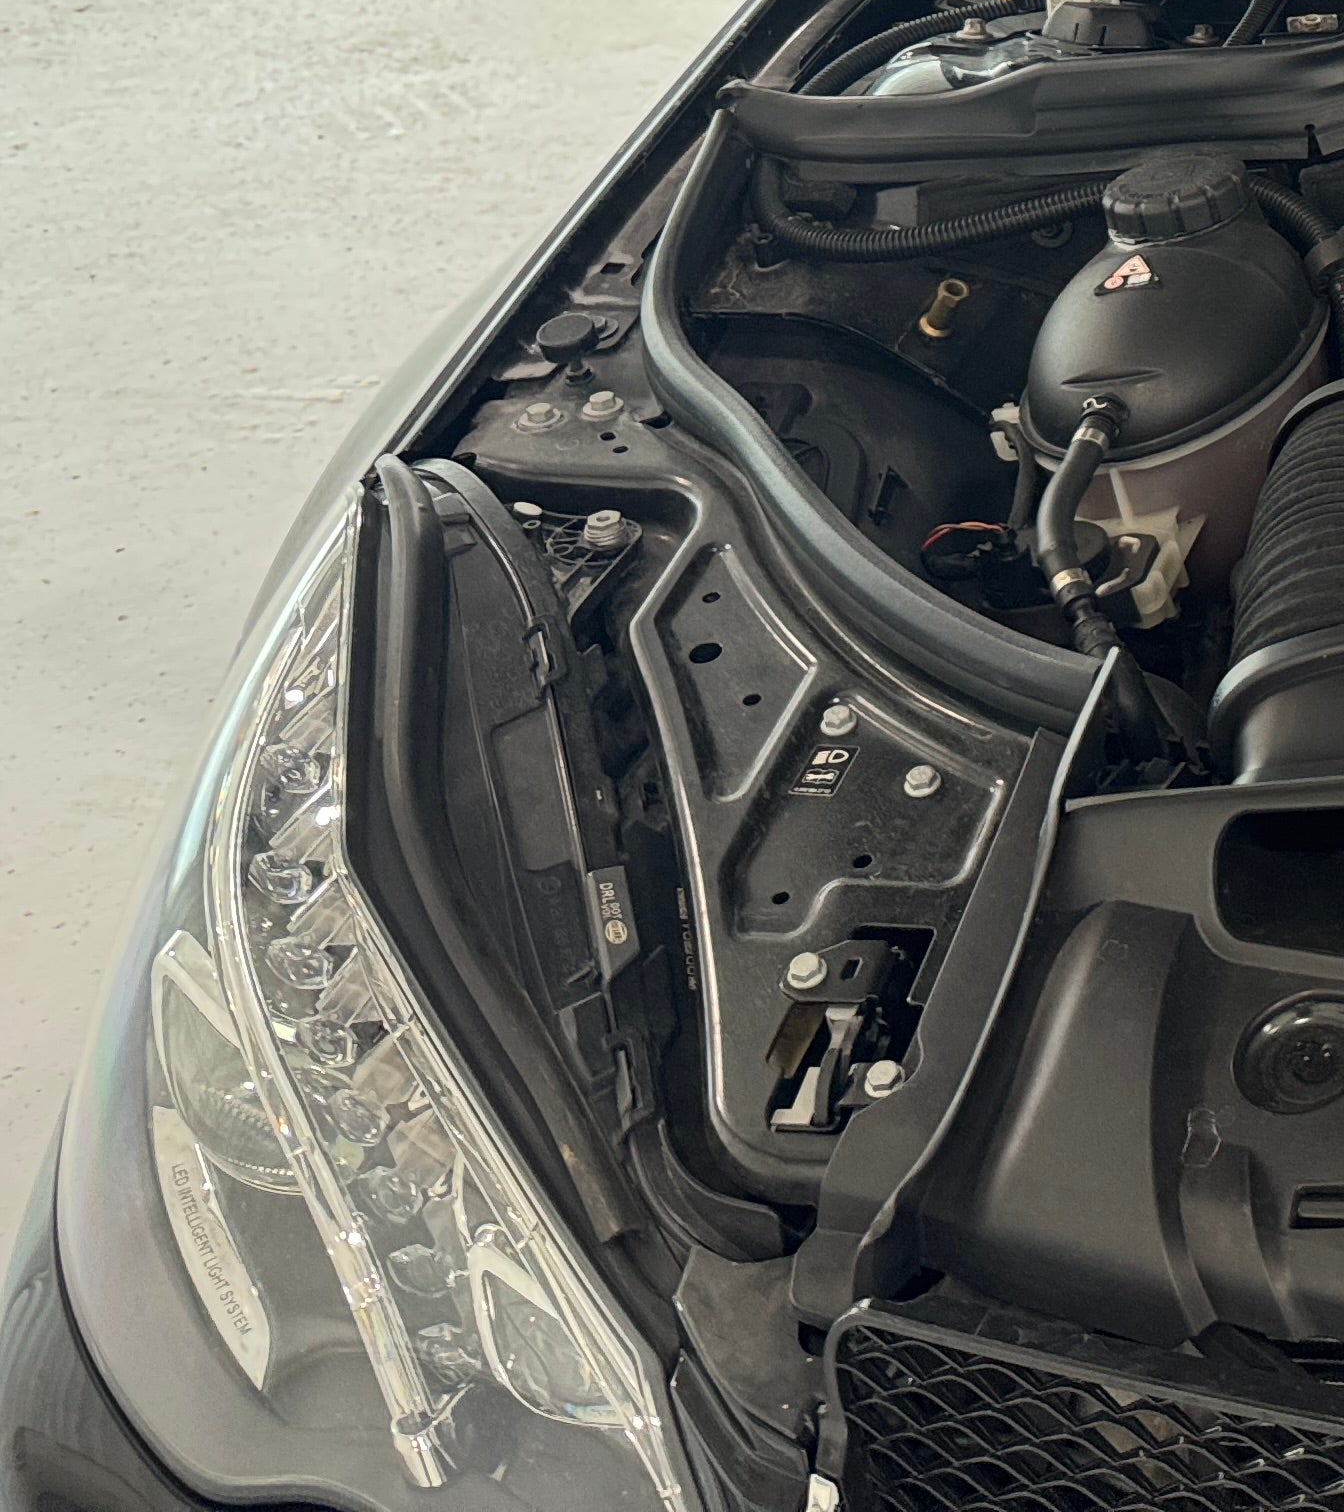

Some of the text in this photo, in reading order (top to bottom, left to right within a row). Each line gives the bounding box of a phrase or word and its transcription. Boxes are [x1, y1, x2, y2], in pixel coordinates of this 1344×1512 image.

[600, 882, 616, 904] DRL
[172, 1163, 253, 1336] LED INTELLIGENT LIGHT SYSTEM
